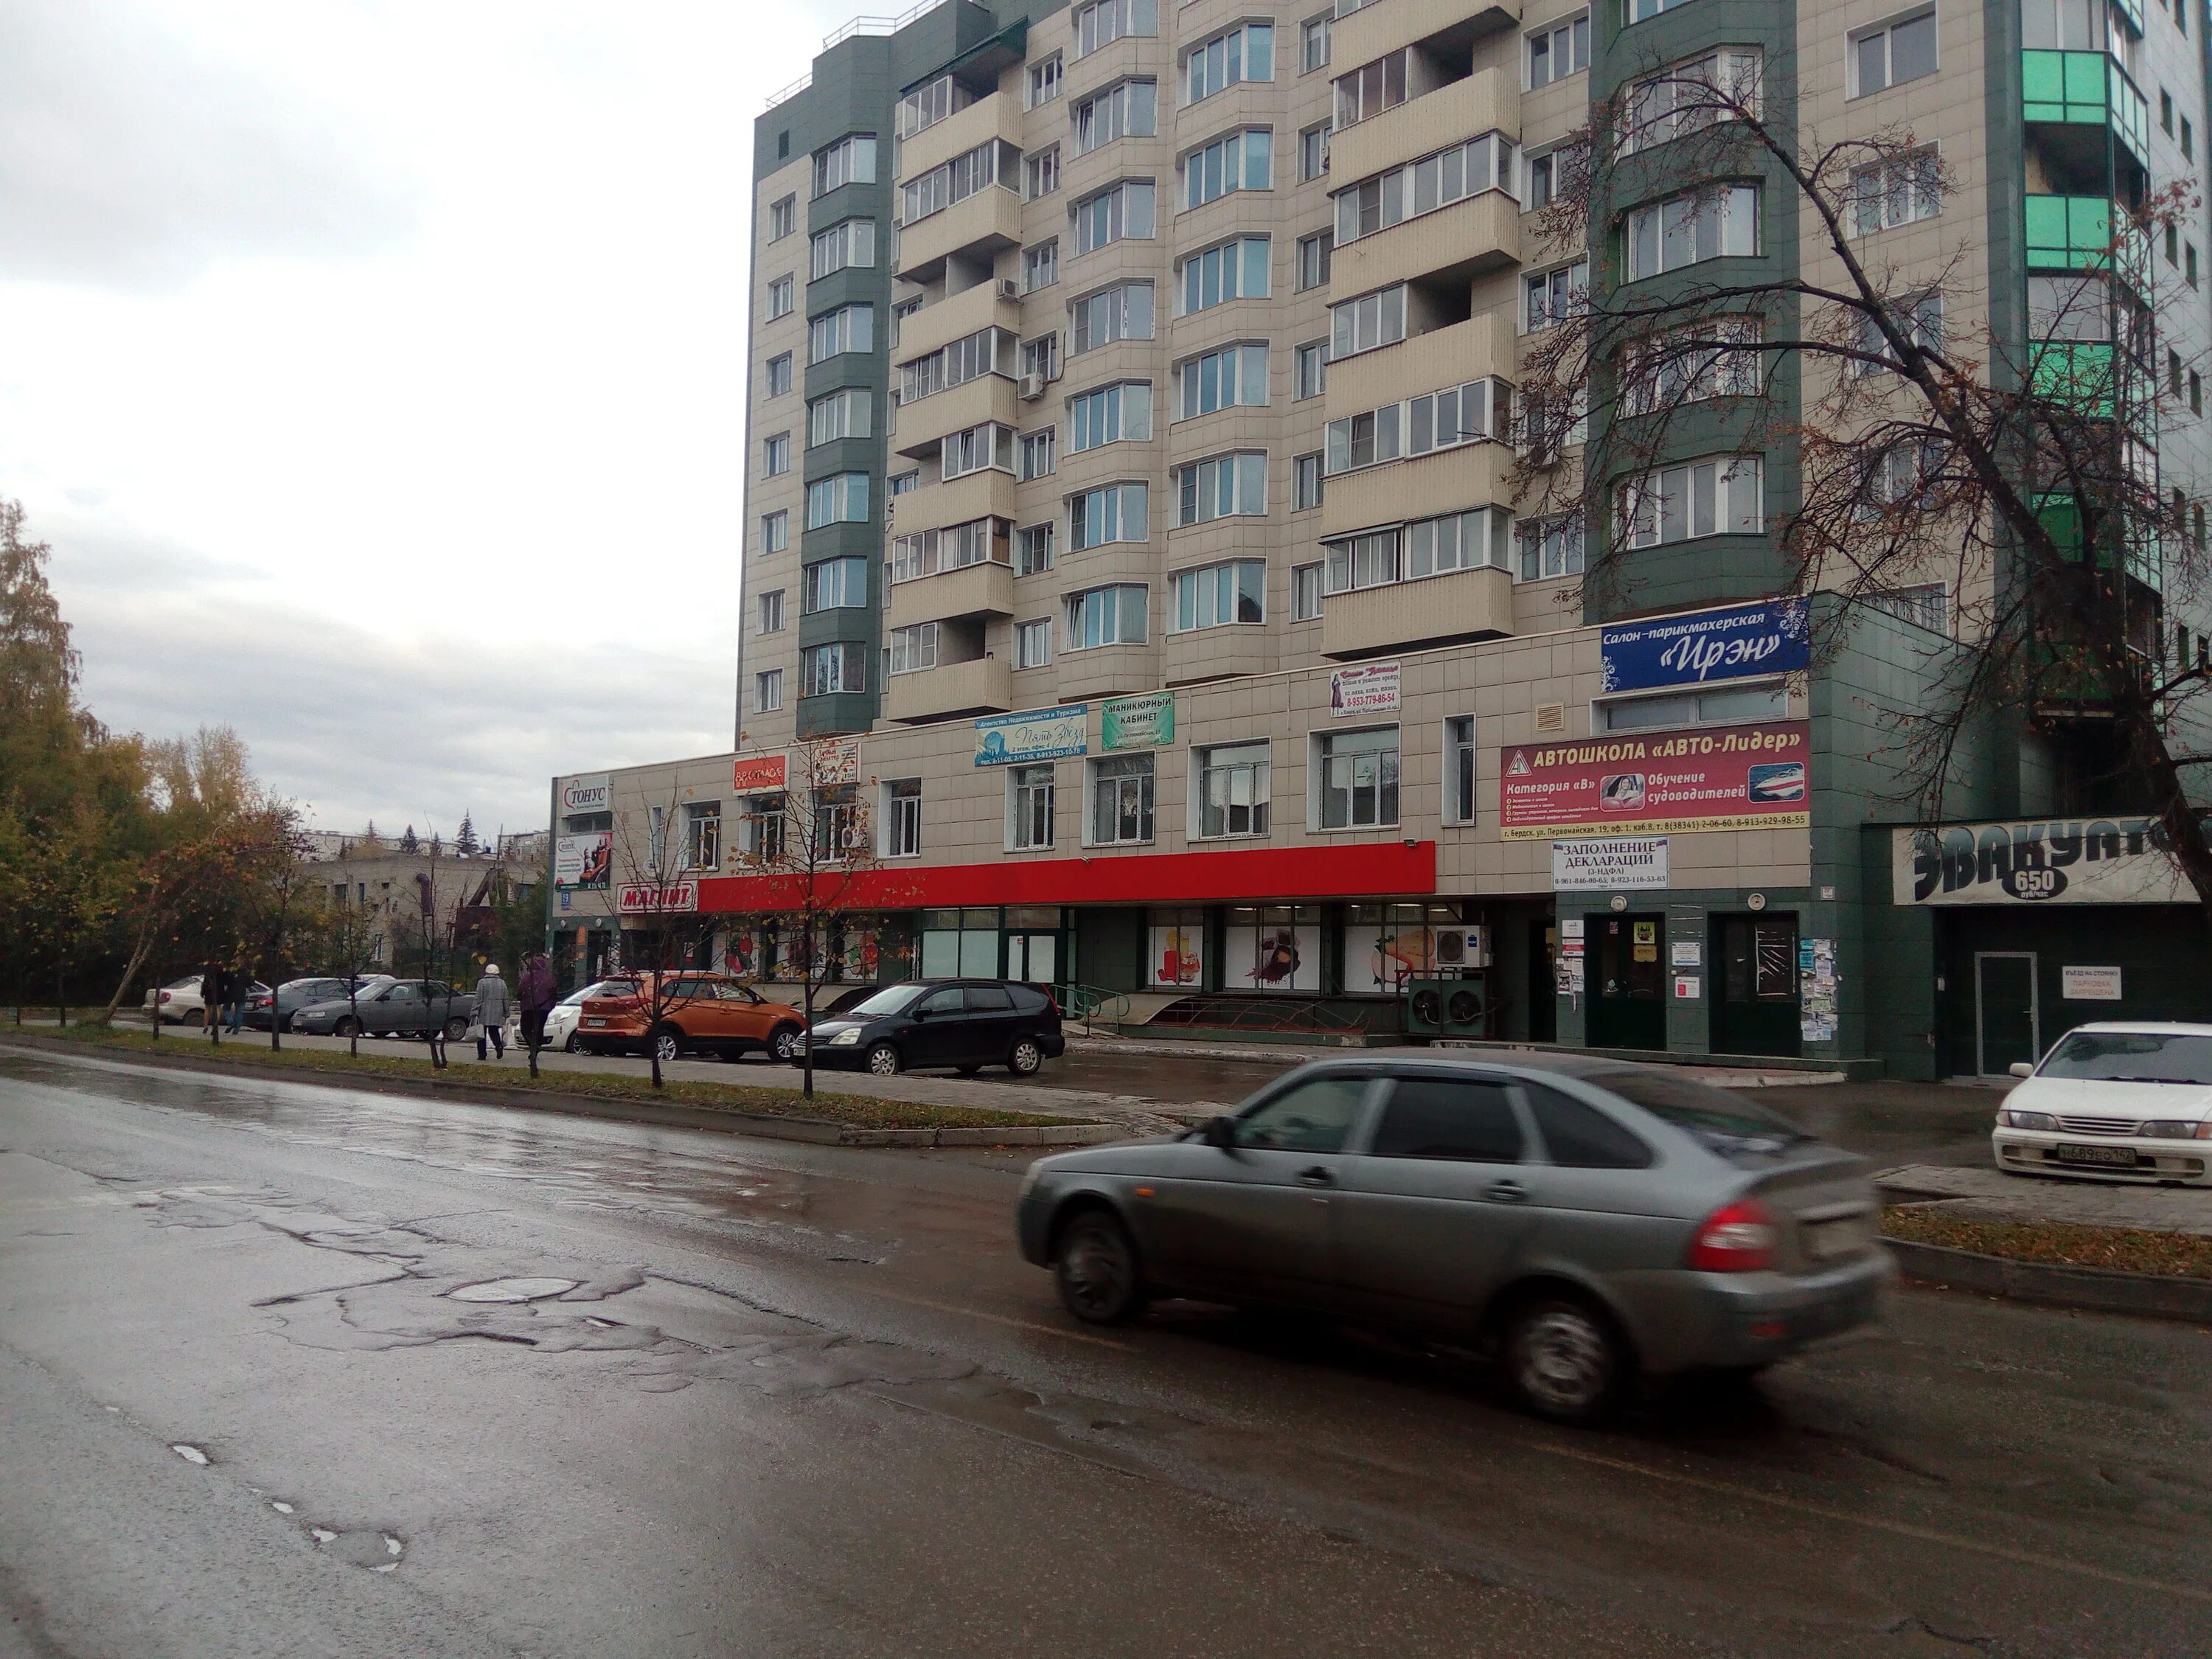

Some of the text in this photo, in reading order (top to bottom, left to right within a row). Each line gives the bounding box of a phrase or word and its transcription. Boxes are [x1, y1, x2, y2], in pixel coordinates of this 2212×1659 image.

[1602, 613, 1765, 645] Салон-парикмахерская
[1660, 633, 1781, 681] «Ирэн»
[1108, 695, 1172, 713] МАНИКЮРНЫЙ
[1346, 692, 1395, 707] 8-953-779-86-54
[1120, 712, 1158, 725] КАБИНЕТ
[1533, 731, 1801, 768] АВТОШКОЛА «АВТО-Лидер»
[1648, 772, 1705, 787] Обучение
[571, 787, 605, 804] ТОНУС
[1506, 782, 1570, 795] Категория
[1648, 785, 1746, 805] судоводителей
[1537, 830, 1546, 838] ул.
[1610, 825, 1624, 835] оф.
[1633, 824, 1655, 832] каб.8,
[1664, 820, 1700, 831] 8(38341)
[1736, 815, 1805, 827] 8-913-929-98-55
[1563, 841, 1656, 855] ЗАПОЛНЕНИЕ
[1565, 852, 1654, 869] ДЕКЛАРАЦИЙ
[1587, 867, 1624, 875] (3-НДФЛ)
[1610, 875, 1666, 884] 8-923-116-53-63
[2015, 870, 2055, 891] 650
[2021, 890, 2048, 898] руб/час
